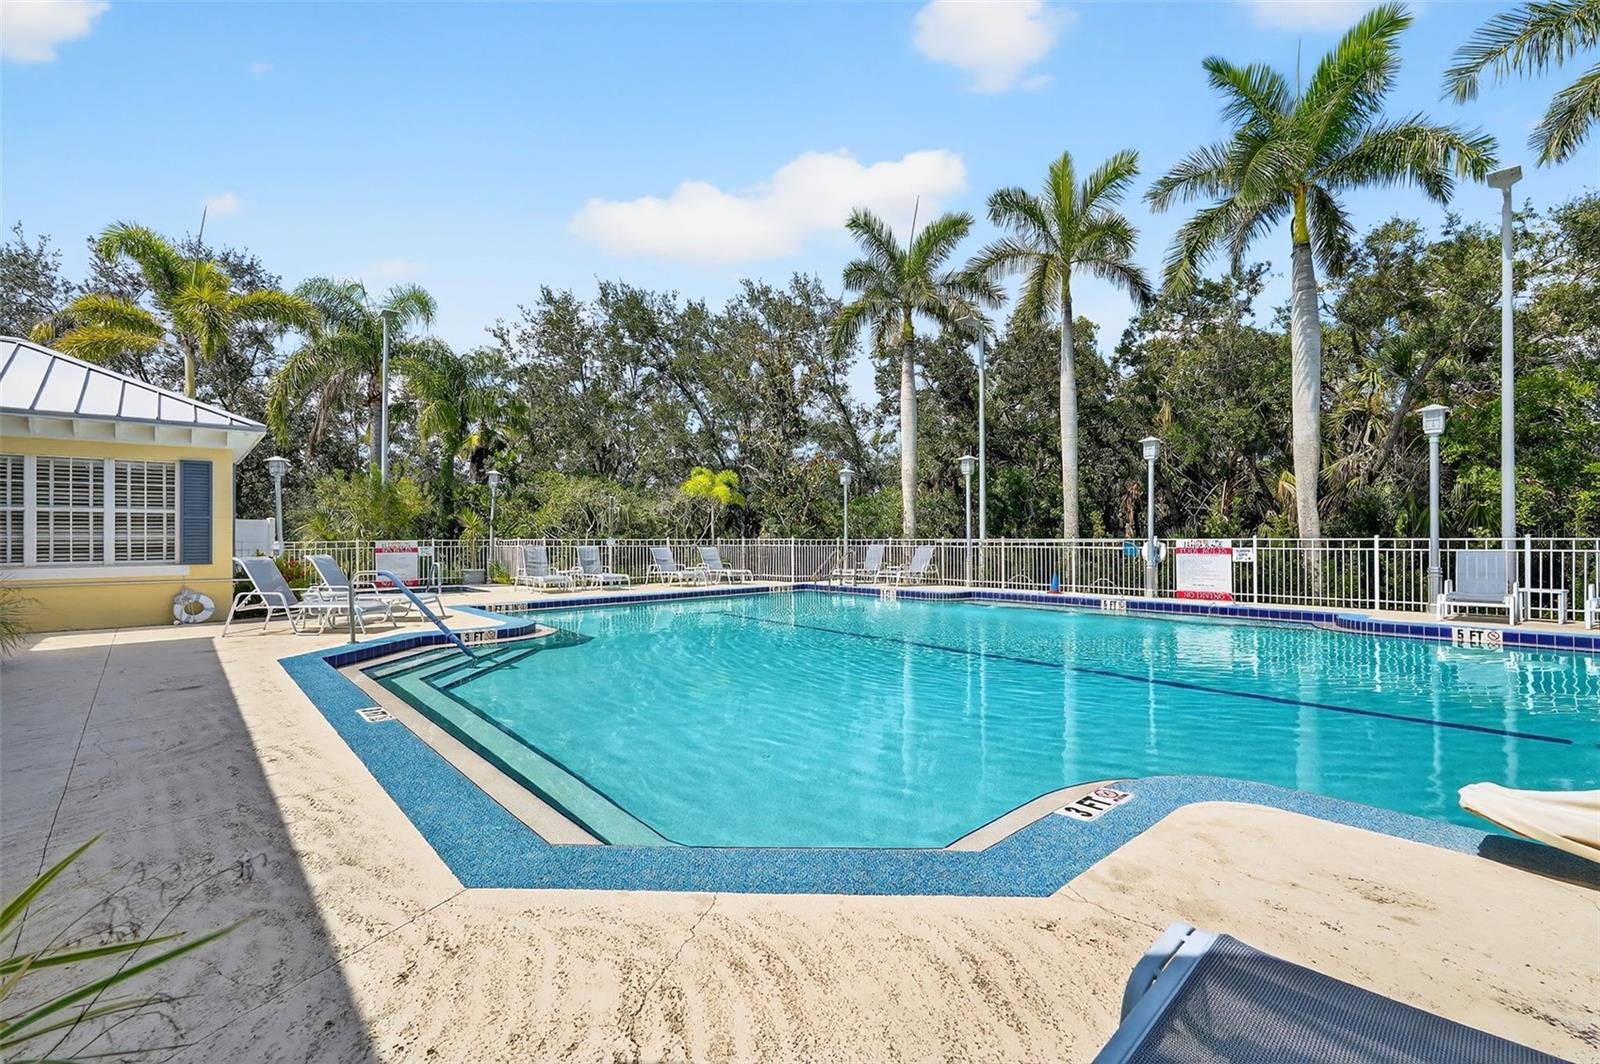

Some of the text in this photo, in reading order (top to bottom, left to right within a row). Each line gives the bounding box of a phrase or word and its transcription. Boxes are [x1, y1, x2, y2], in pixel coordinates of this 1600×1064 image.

[464, 631, 485, 642] 3 FT
[1457, 629, 1484, 641] 5 FT
[1075, 795, 1112, 811] FT
[1064, 806, 1093, 817] 3
